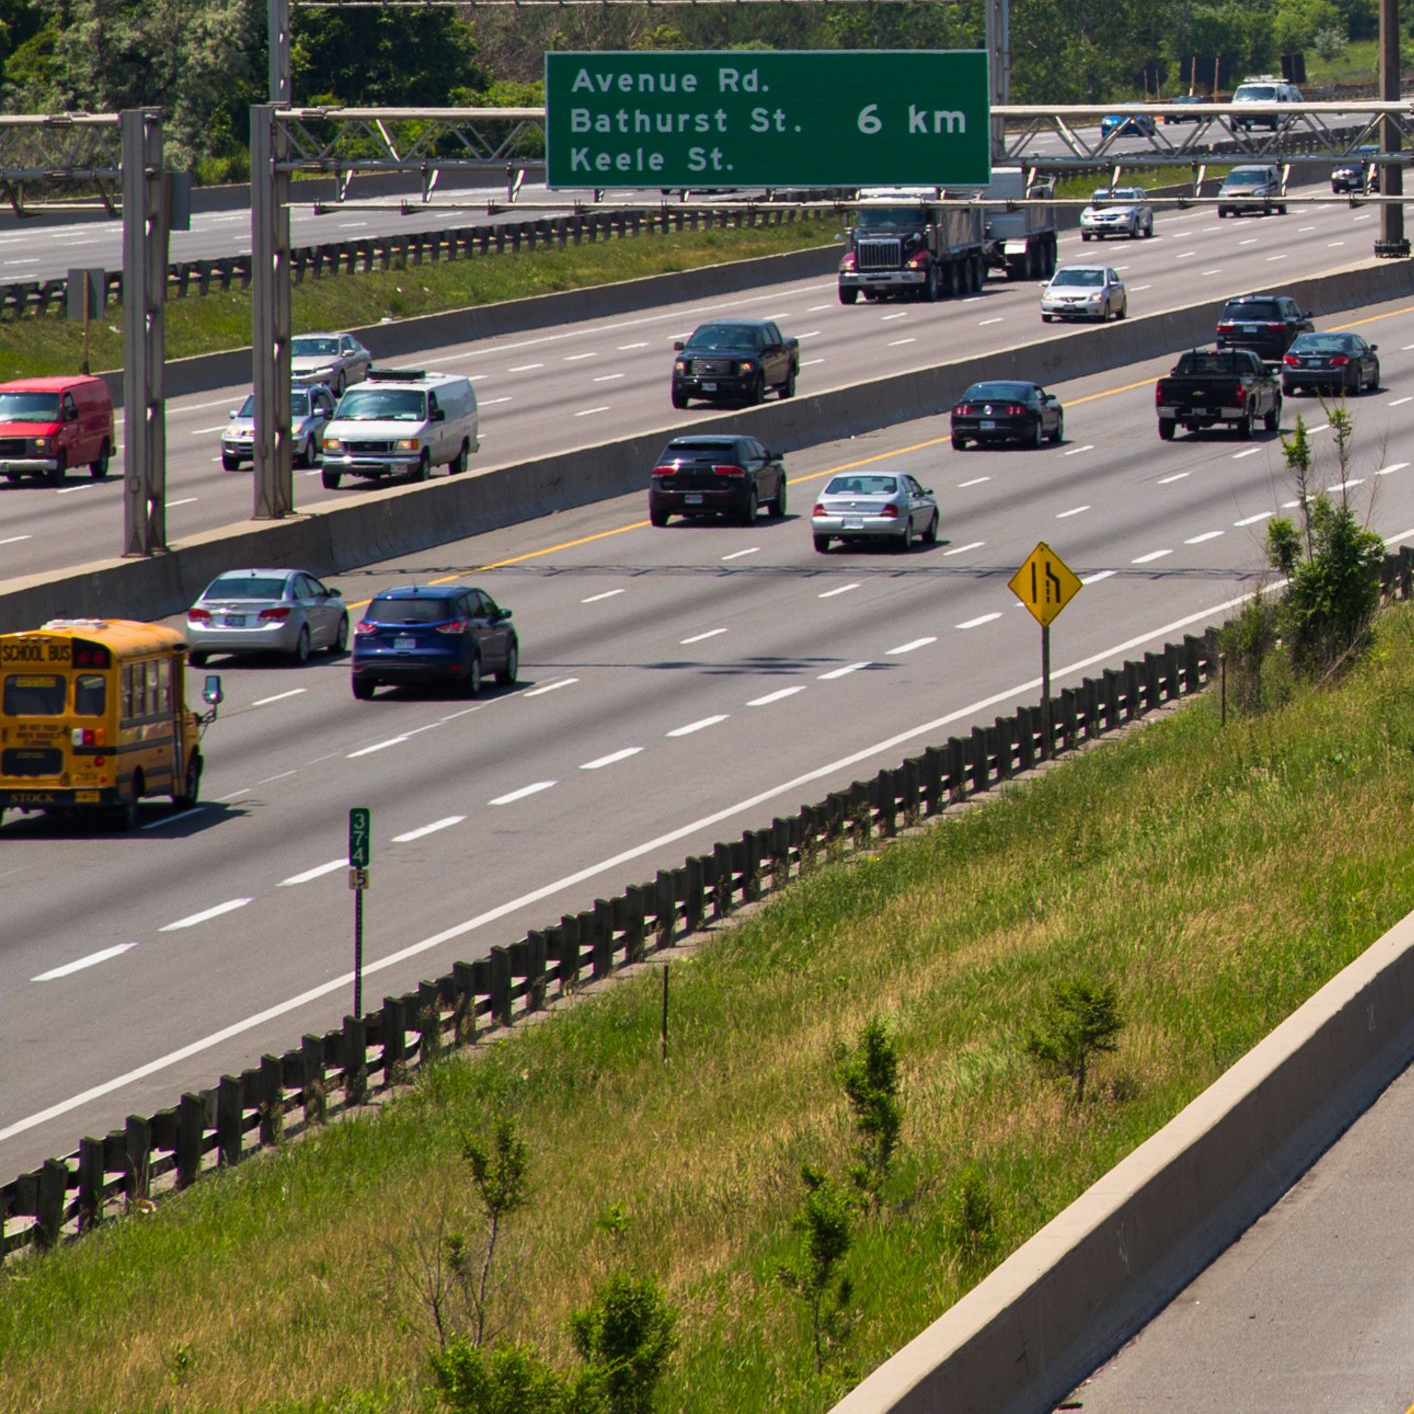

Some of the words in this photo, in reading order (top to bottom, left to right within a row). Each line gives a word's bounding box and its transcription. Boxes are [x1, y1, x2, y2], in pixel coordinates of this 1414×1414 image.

[571, 68, 698, 93] Avenue
[719, 68, 770, 93] Rd.
[571, 108, 728, 133] Bathurst
[751, 108, 803, 133] St.
[858, 104, 882, 134] 6
[908, 104, 967, 134] km
[571, 147, 665, 172] Keele
[687, 147, 735, 172] St.
[3, 645, 45, 662] SCHOOL
[49, 645, 70, 661] BUS
[11, 793, 55, 803] STOCK
[352, 813, 366, 864] 374
